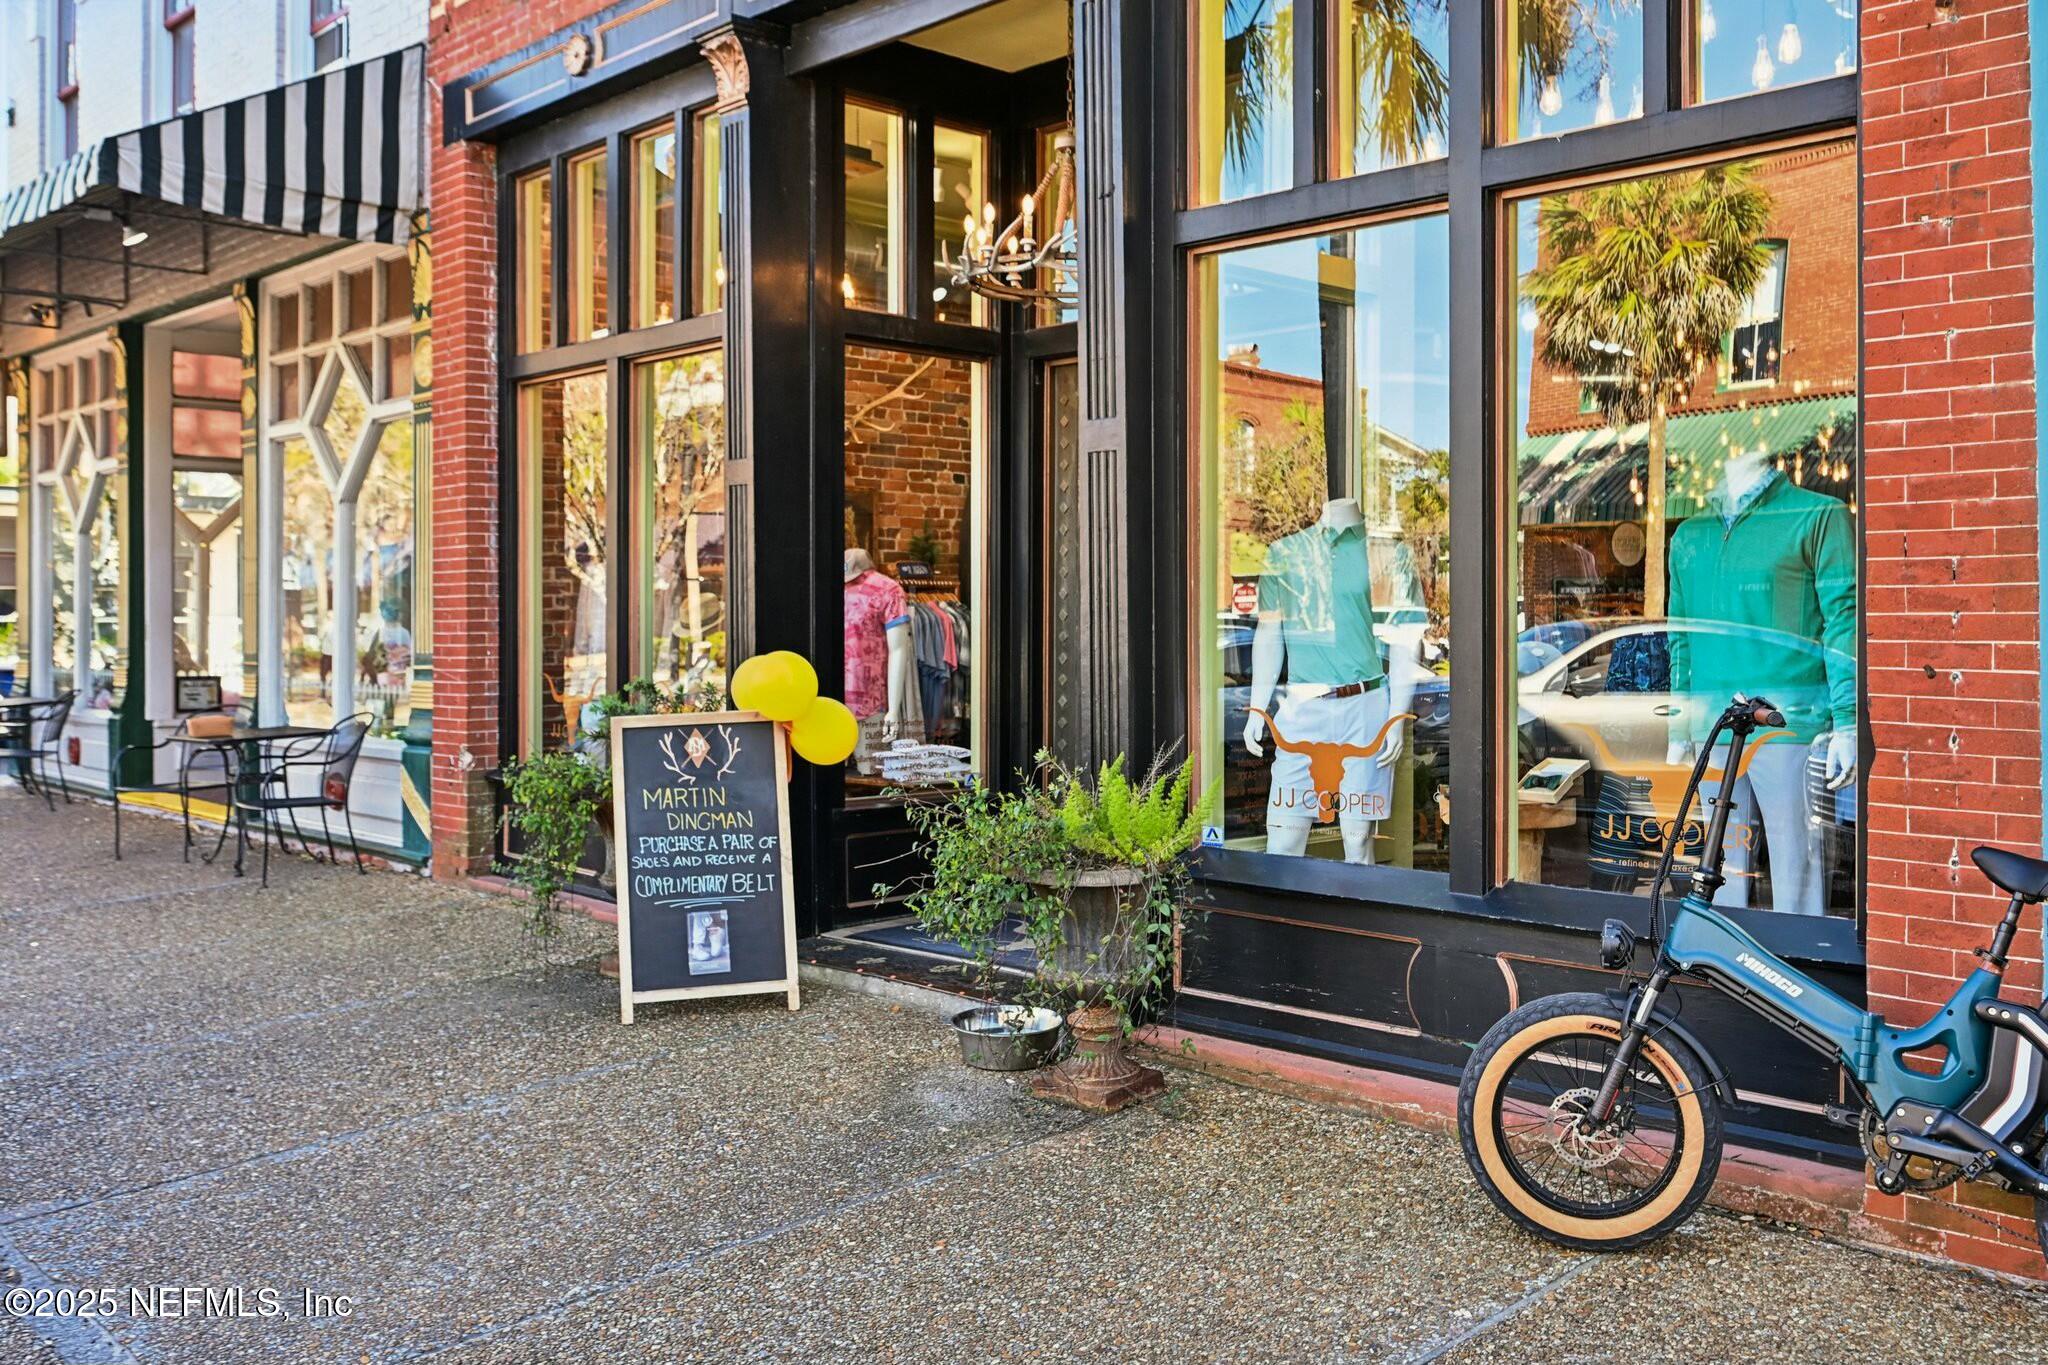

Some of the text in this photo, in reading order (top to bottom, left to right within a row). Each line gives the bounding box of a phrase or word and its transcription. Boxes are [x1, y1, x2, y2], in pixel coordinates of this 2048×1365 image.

[642, 786, 727, 810] MARTIN
[1302, 789, 1385, 817] COOPER
[666, 810, 754, 831] DINGMAN
[1600, 814, 1753, 851] JJ COOER
[639, 833, 778, 854] PURCHASE A PAIR OF
[631, 853, 772, 869] SHOES AND RECEIVE A
[634, 872, 776, 898] COMPLIMENTARY BELT
